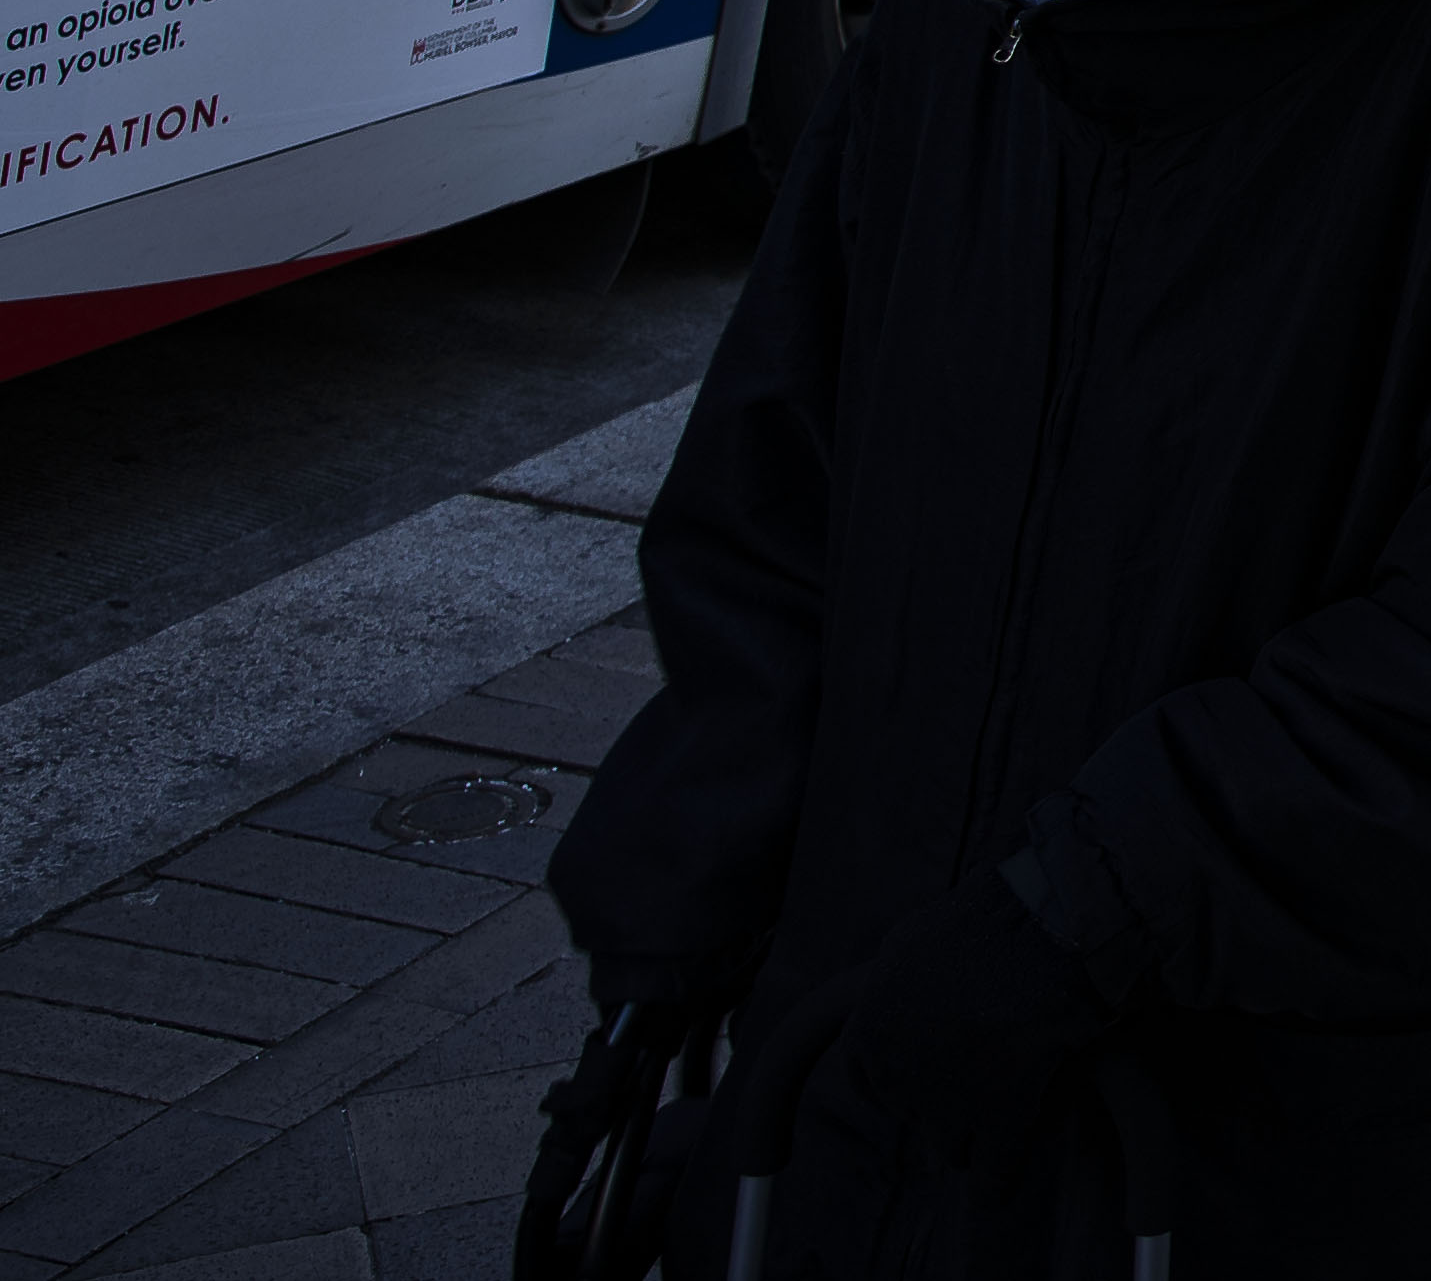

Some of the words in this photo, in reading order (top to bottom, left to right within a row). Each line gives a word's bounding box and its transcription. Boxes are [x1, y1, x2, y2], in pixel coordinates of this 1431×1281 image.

[6, 21, 48, 51] an
[57, 20, 186, 87] yourself.
[0, 94, 230, 188] IFICATION.
